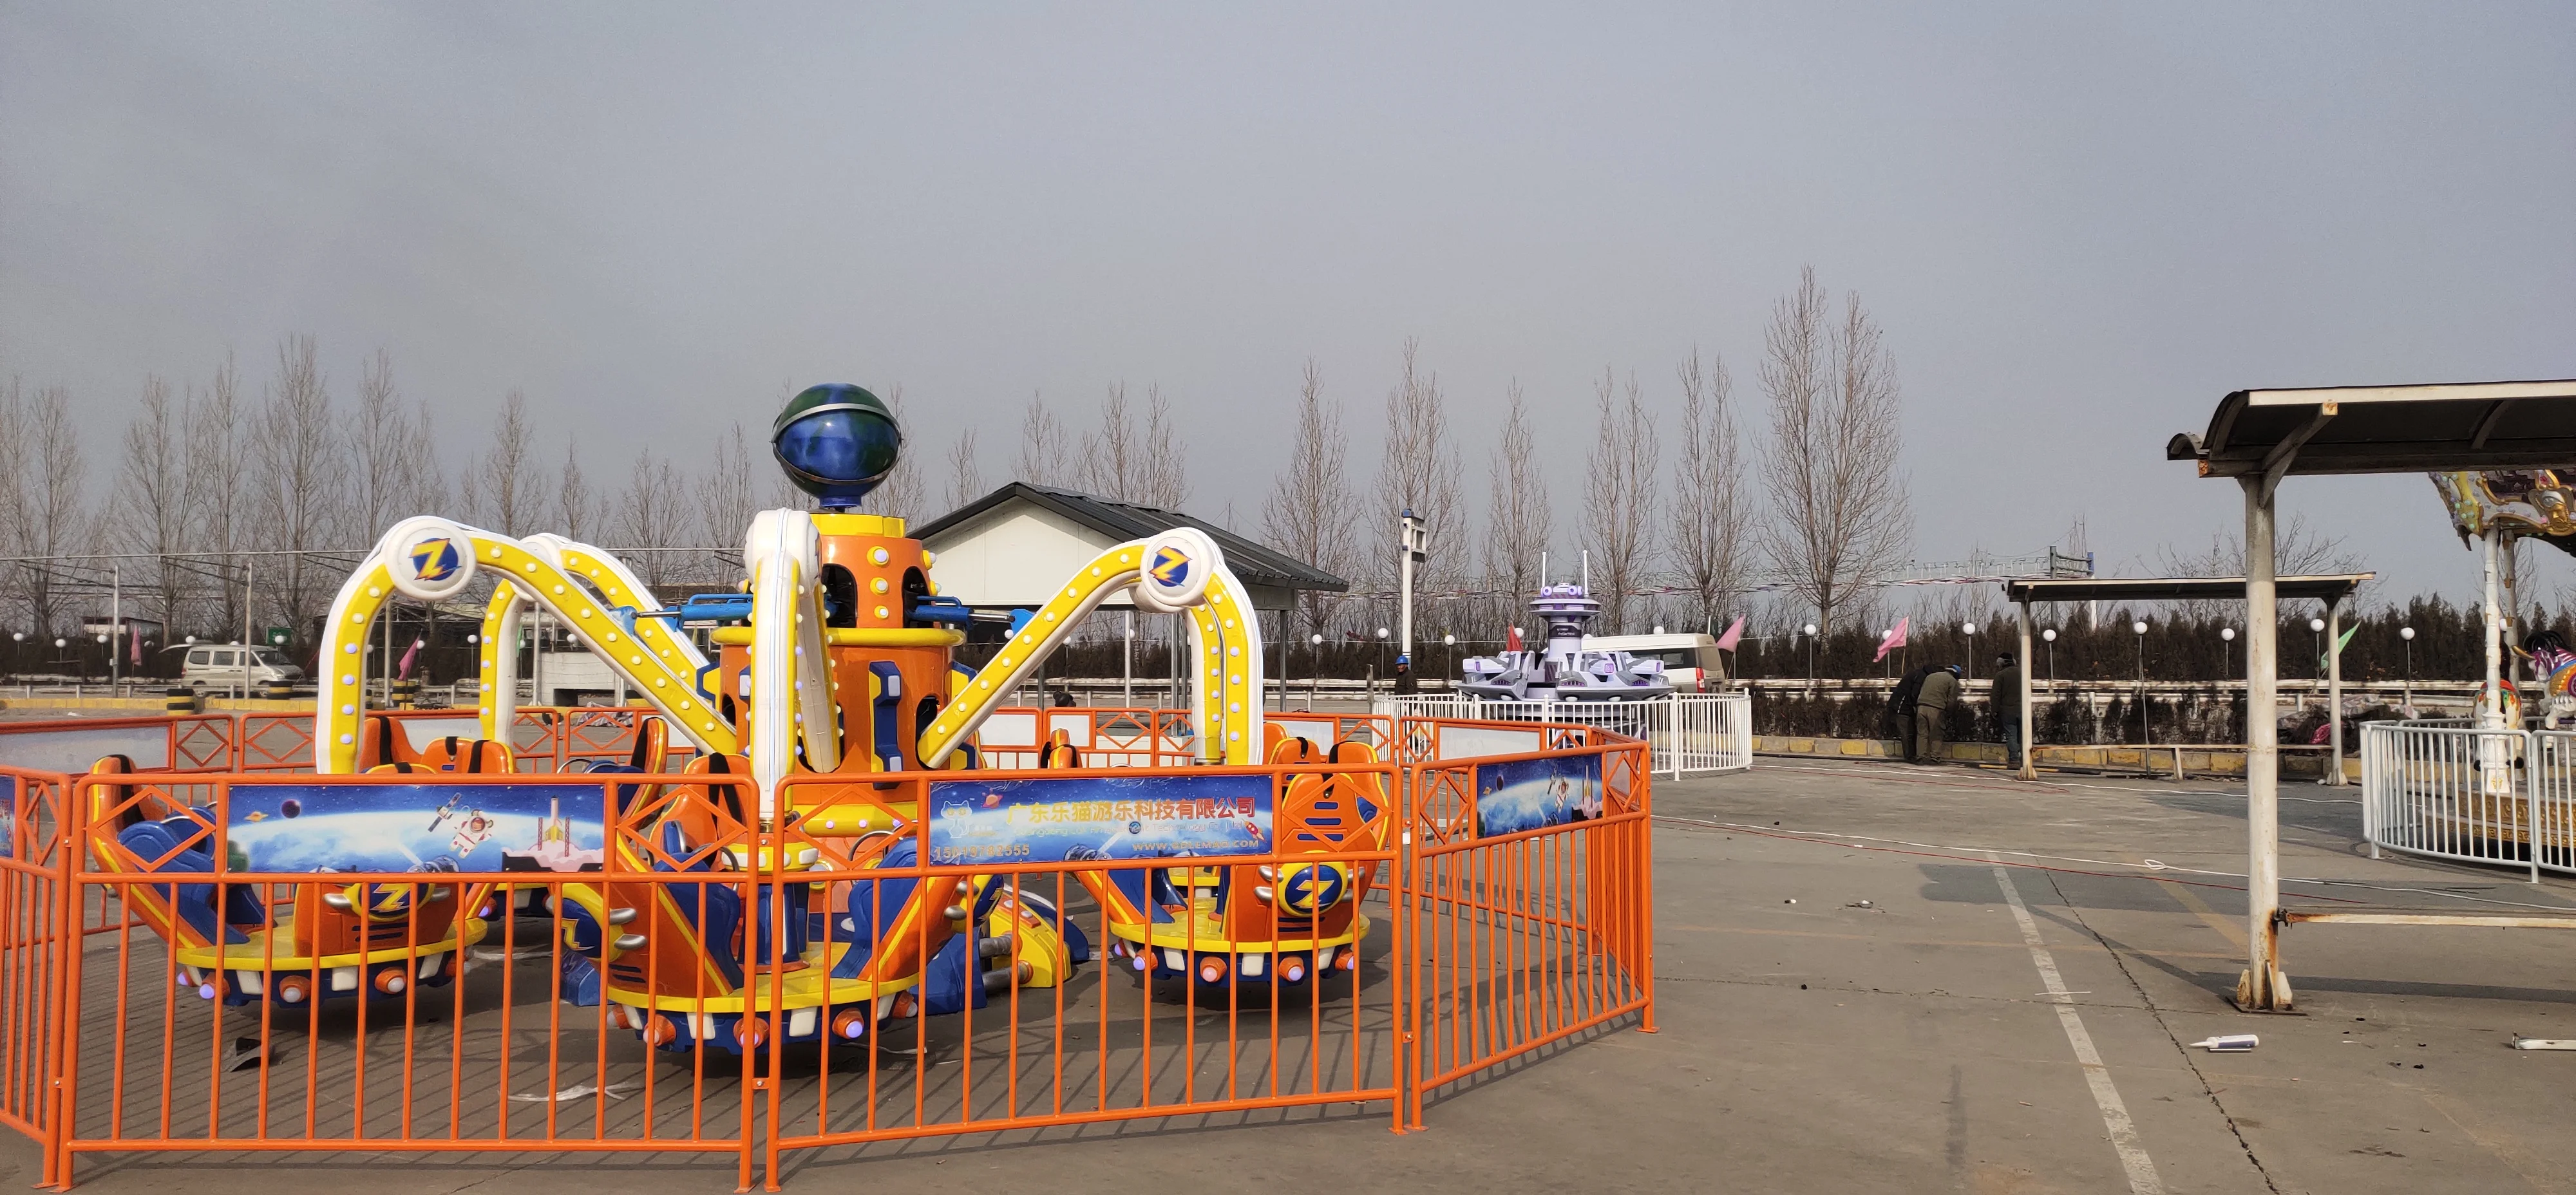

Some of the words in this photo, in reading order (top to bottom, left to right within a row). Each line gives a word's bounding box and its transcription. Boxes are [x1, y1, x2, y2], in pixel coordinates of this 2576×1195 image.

[1007, 796, 1255, 825] 广东乐猫游乐科技有限公司
[934, 844, 1030, 860] 15019782555
